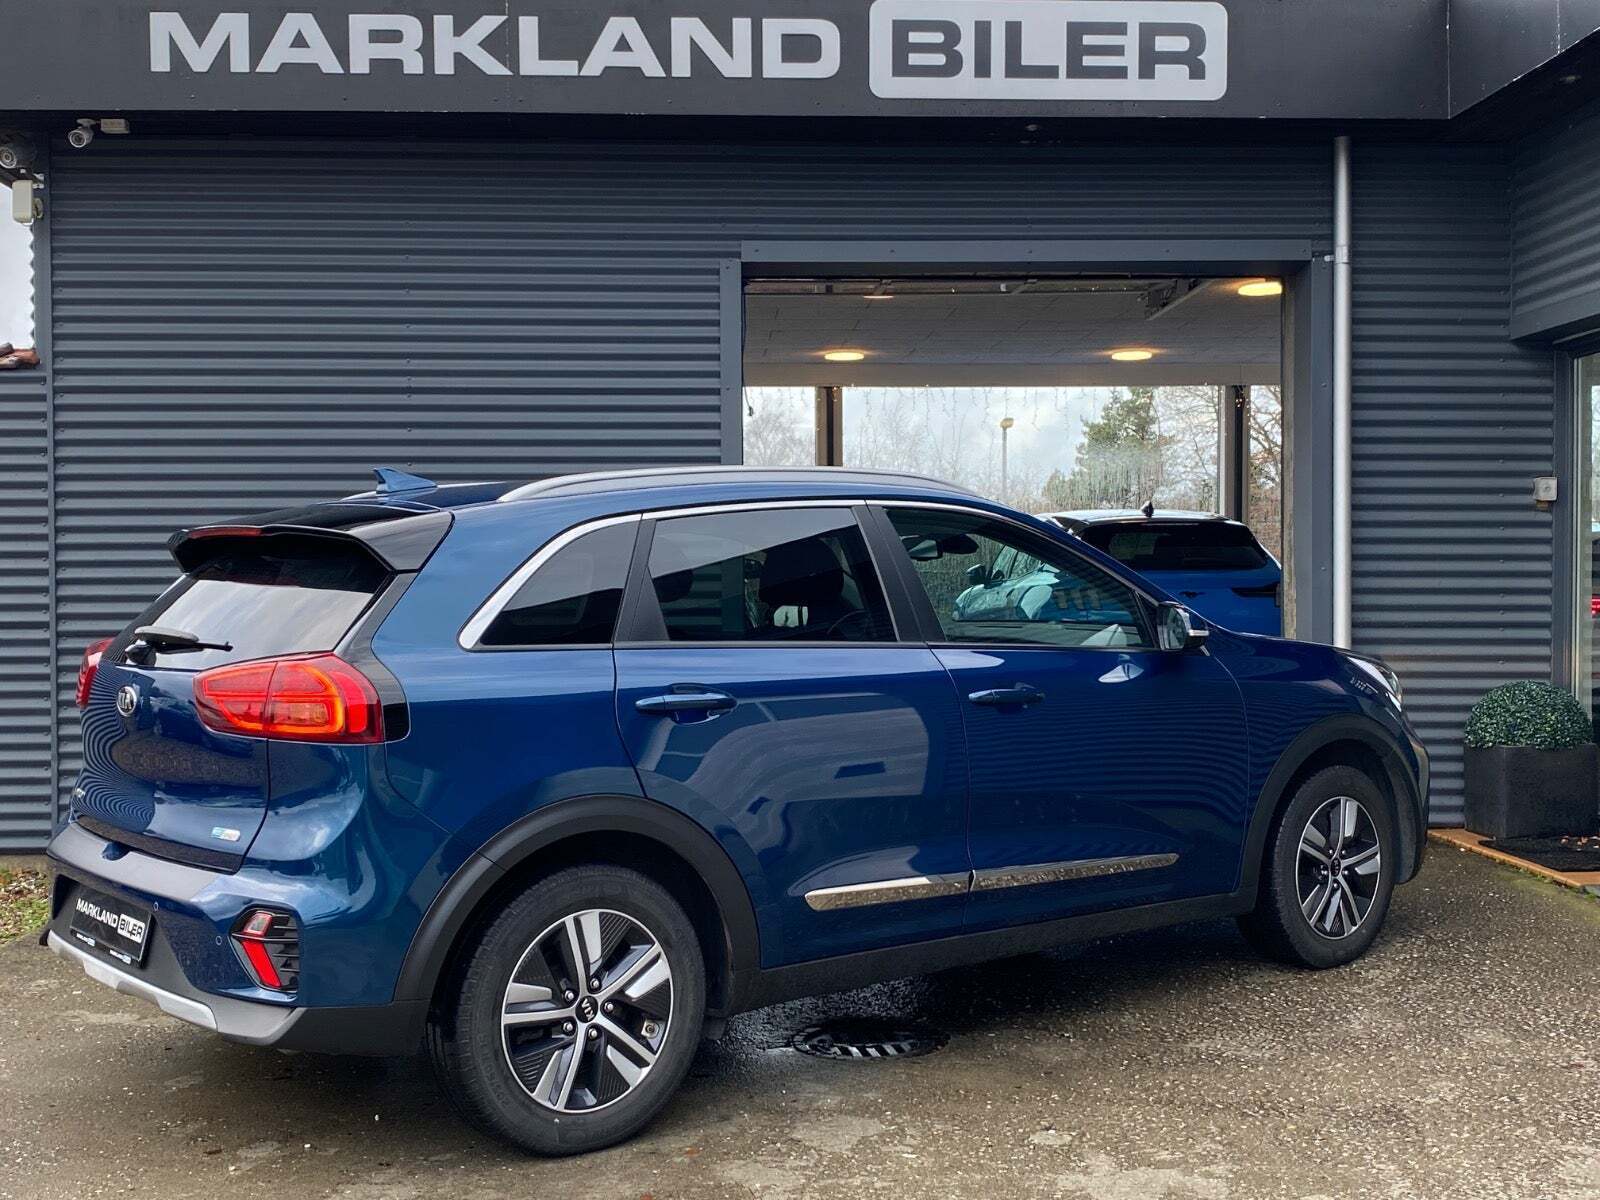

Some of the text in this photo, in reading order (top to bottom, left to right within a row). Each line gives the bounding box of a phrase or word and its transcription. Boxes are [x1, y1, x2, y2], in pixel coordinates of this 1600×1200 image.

[149, 11, 1208, 81] MARKLAND BILER
[76, 897, 144, 939] MARKLAND BILER
